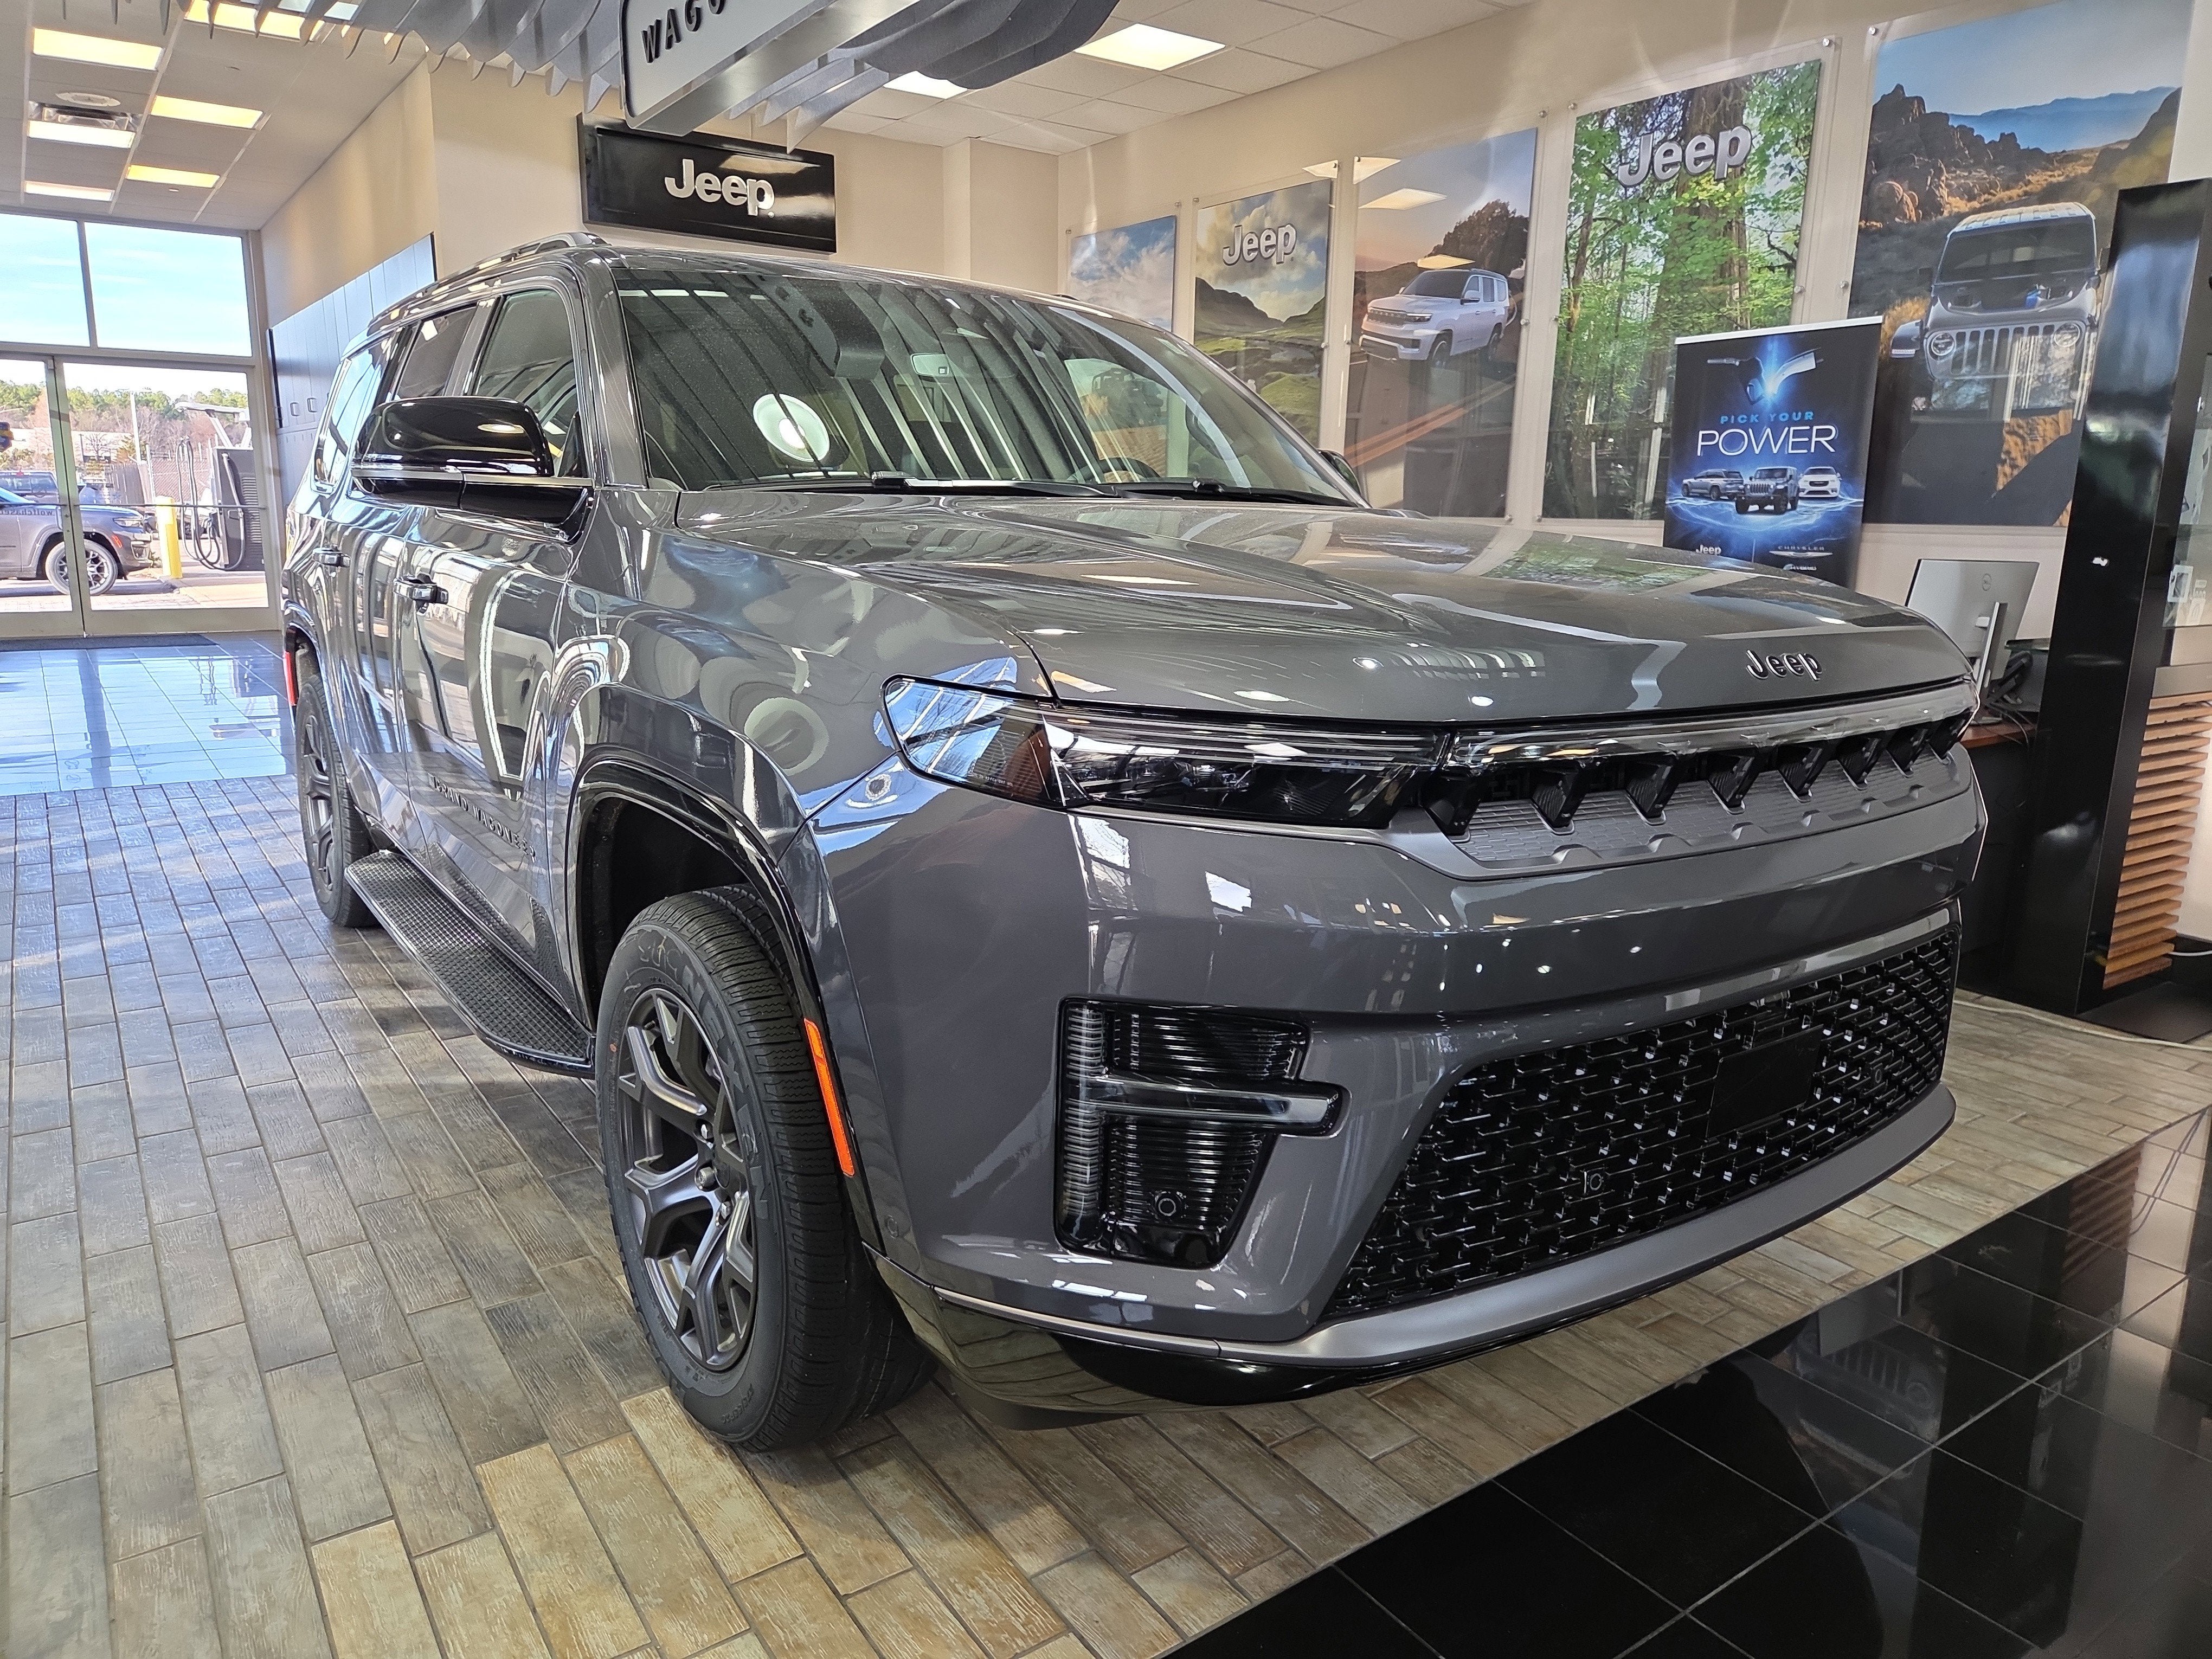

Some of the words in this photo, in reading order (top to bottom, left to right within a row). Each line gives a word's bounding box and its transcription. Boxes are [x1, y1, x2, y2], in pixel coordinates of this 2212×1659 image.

[1618, 125, 1752, 188] Jeep
[665, 159, 774, 216] Jeep
[1223, 224, 1296, 266] Jeep
[1720, 414, 1759, 425] PICK
[1770, 411, 1814, 422] YOUR
[1697, 425, 1837, 456] POWER
[1696, 544, 1722, 556] Jeep
[1746, 650, 1822, 680] Jeep
[434, 776, 468, 812] GRAND
[473, 805, 537, 863] WAGONEER
